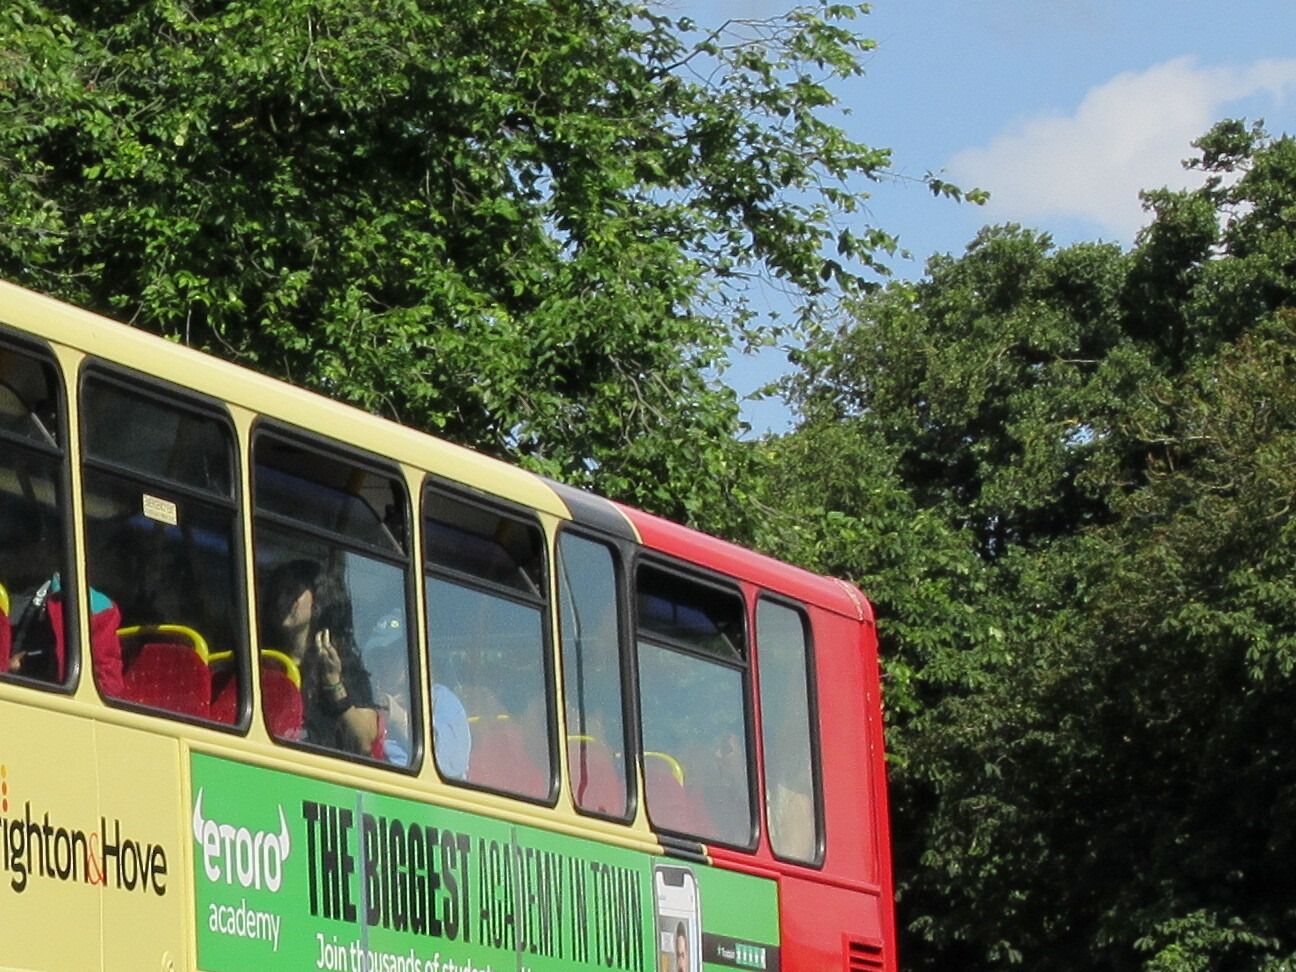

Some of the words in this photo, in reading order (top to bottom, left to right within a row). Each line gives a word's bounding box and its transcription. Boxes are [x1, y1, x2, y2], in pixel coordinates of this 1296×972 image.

[302, 799, 358, 924] THE
[362, 812, 471, 943] BIGGEST
[479, 837, 563, 960] ACADEMY
[569, 856, 588, 964] IN
[590, 860, 643, 972] TOWN
[208, 897, 281, 952] academy
[316, 933, 348, 972] Join
